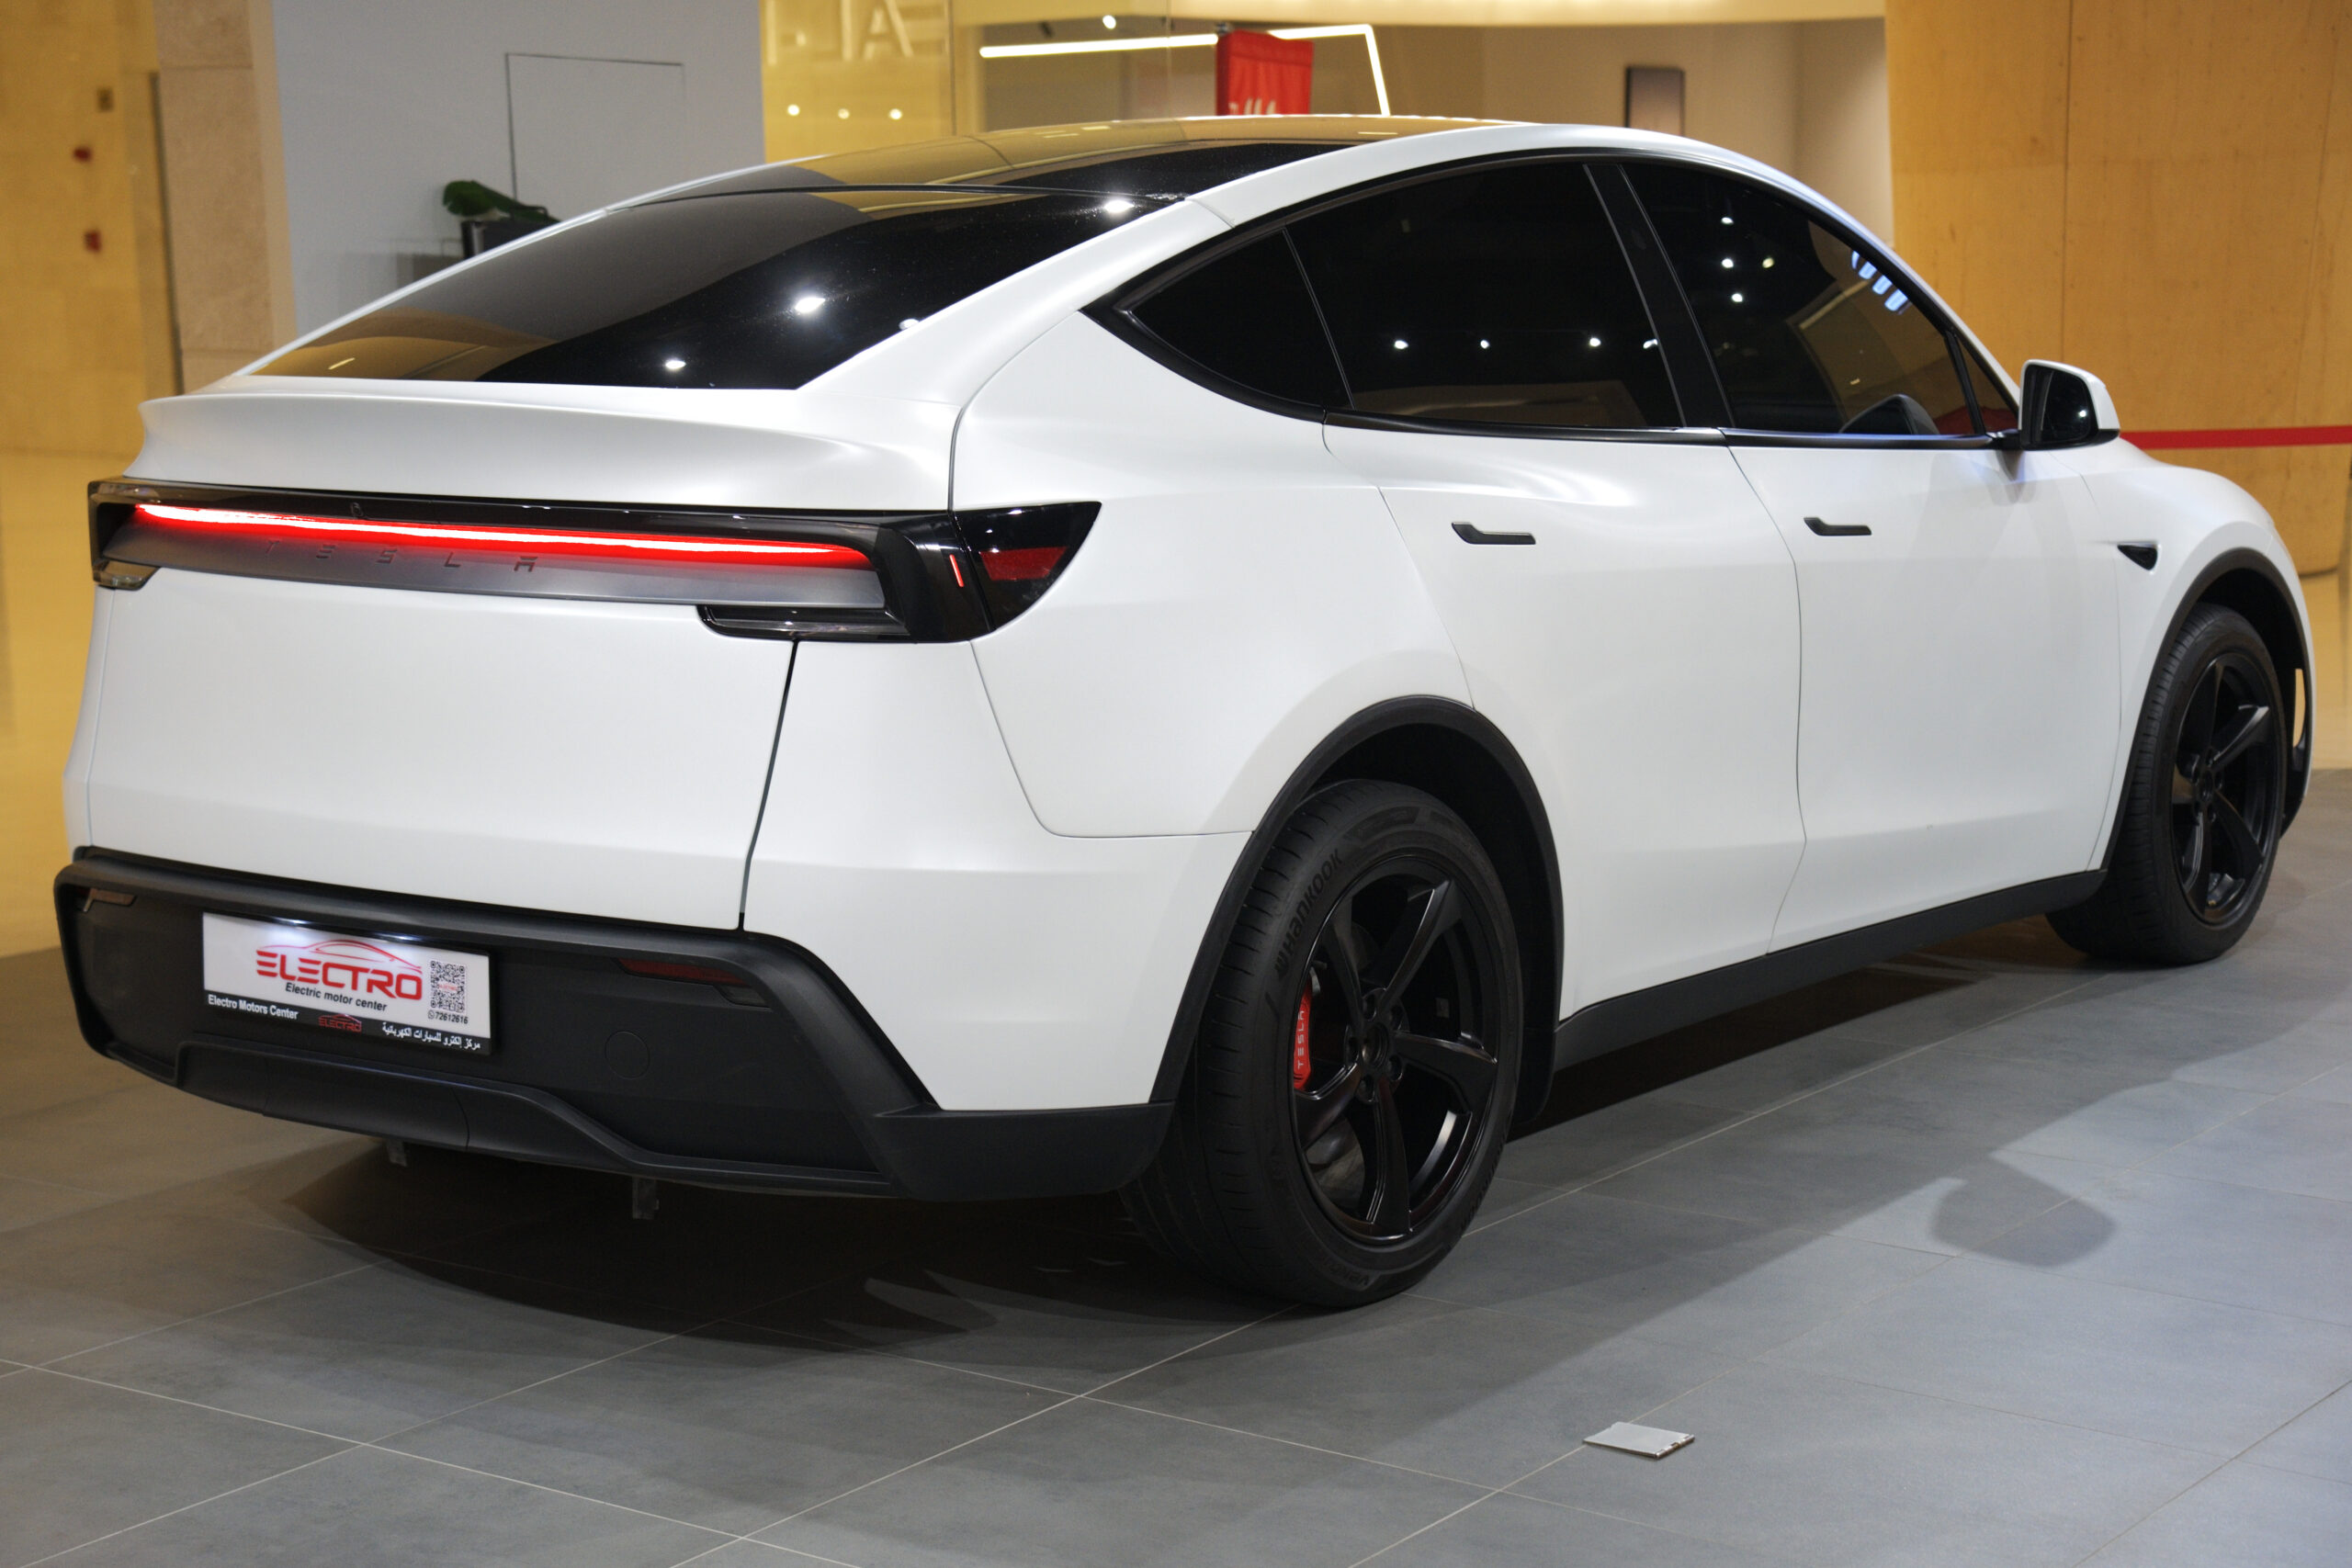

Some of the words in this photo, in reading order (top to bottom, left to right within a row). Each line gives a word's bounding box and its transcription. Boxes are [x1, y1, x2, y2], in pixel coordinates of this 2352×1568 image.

[265, 539, 539, 573] TESLA
[256, 950, 423, 1001] ELECTRO
[208, 994, 237, 1010] Electro
[239, 999, 268, 1015] Motors
[270, 1005, 300, 1020] Center
[285, 982, 322, 999] Electric
[324, 992, 353, 1006] motor
[356, 998, 388, 1012] center
[319, 1016, 362, 1033] ELECTRO
[435, 1011, 469, 1024] 72612616
[464, 1038, 481, 1050] مركز
[1297, 1010, 1306, 1070] TESLA
